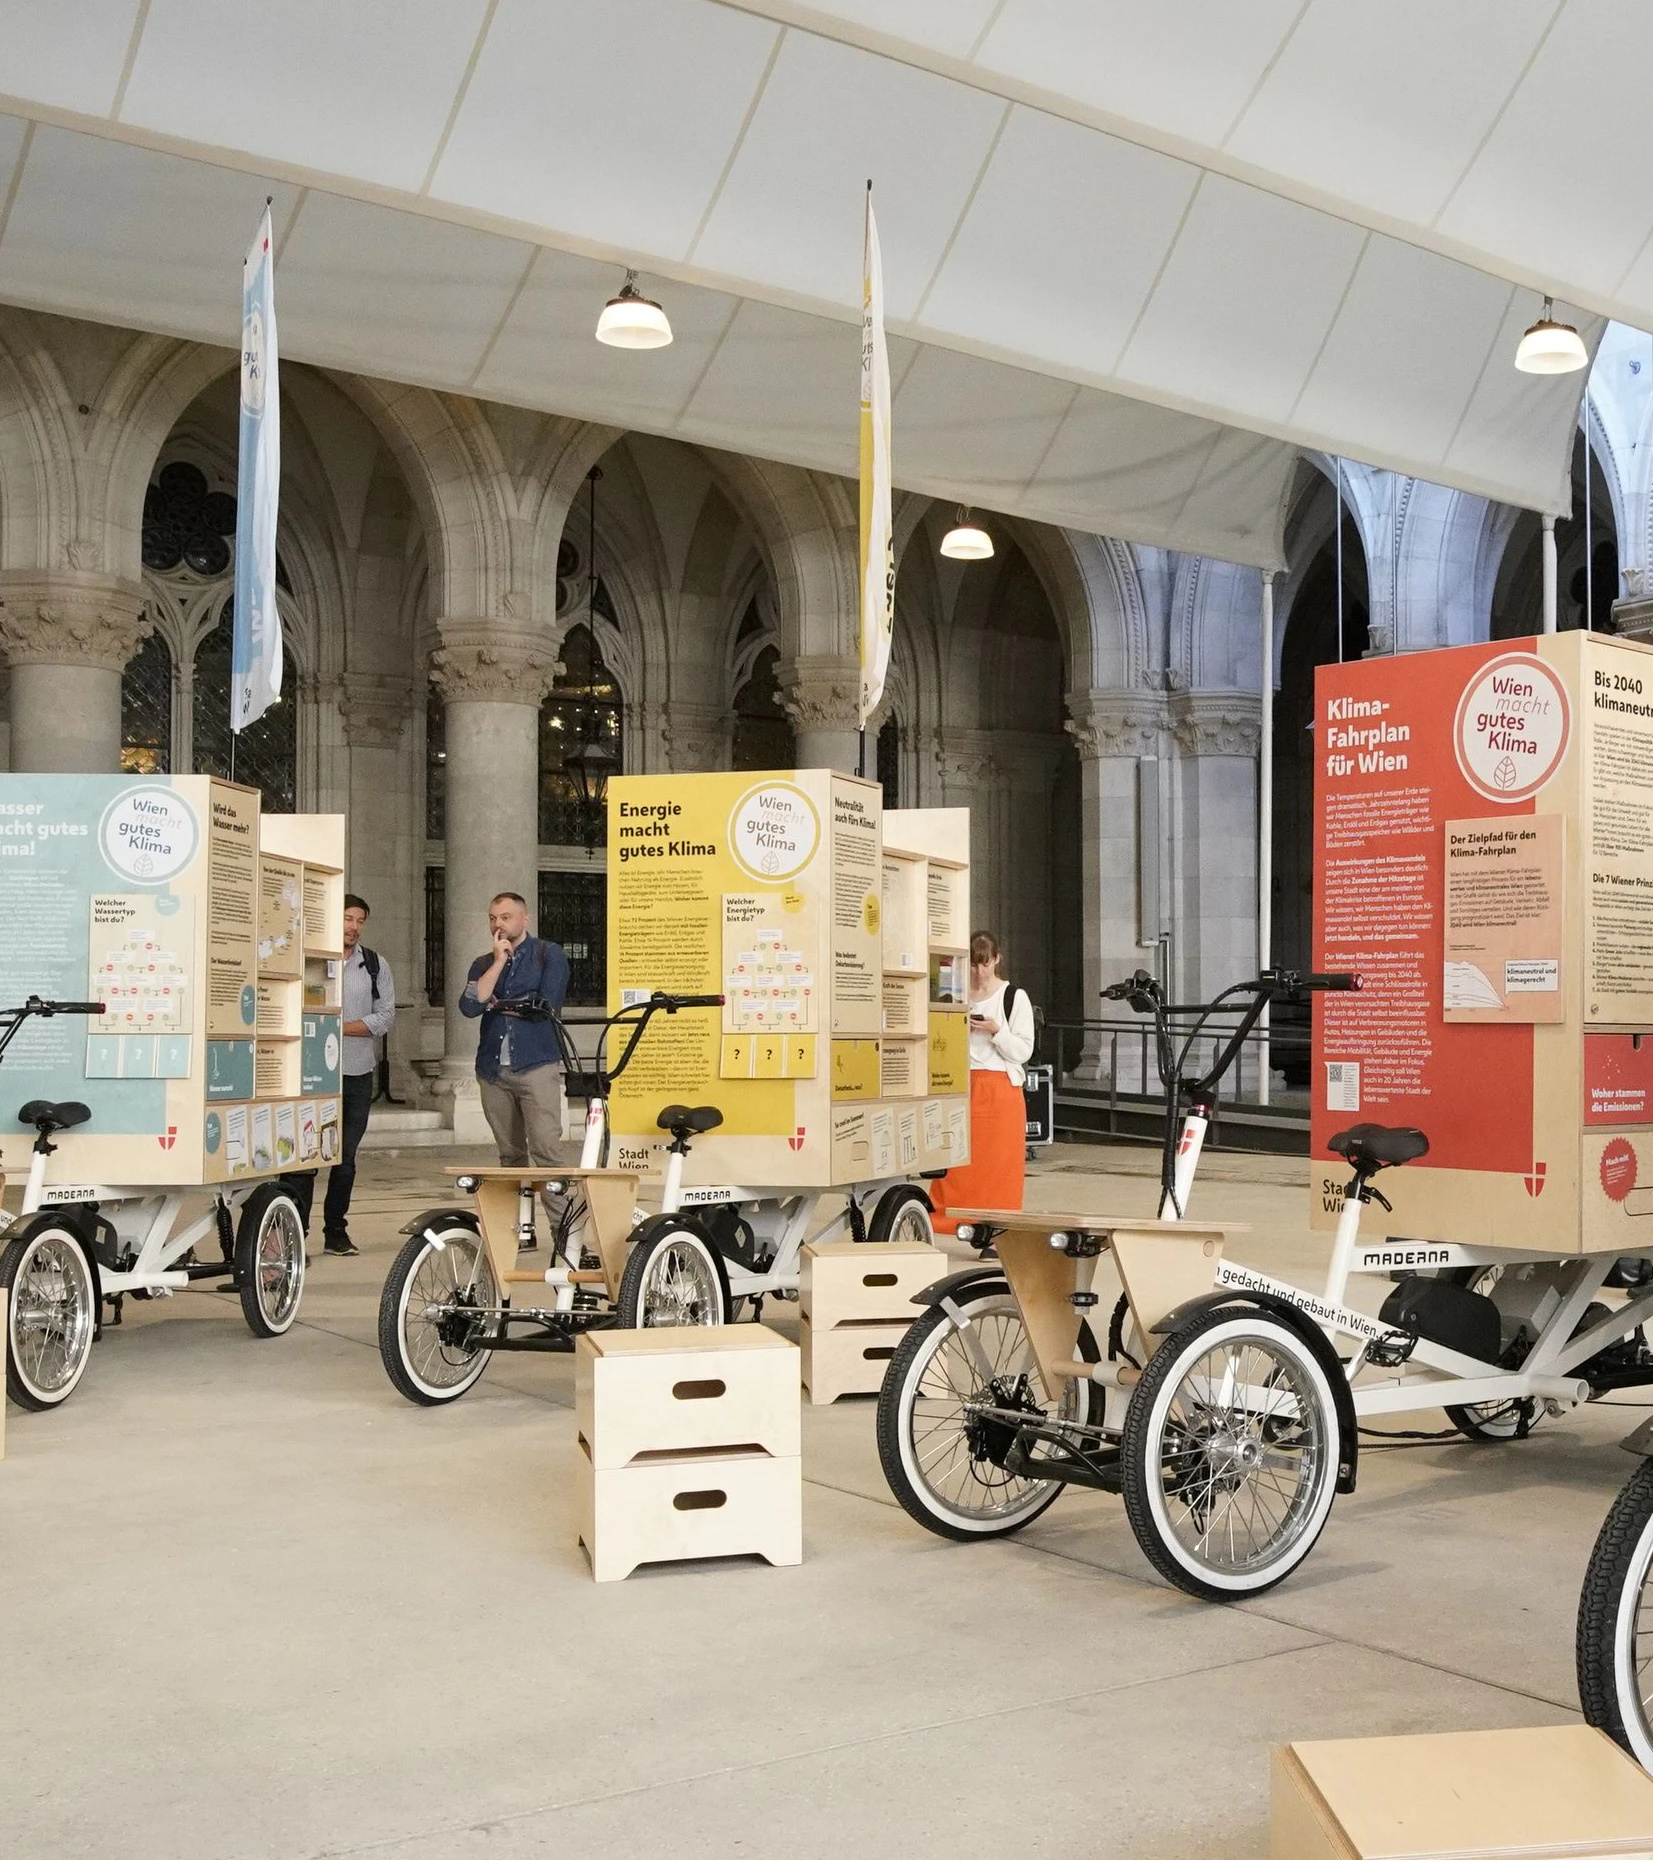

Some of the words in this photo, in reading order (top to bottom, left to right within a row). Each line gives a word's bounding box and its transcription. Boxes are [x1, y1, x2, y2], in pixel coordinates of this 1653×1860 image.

[1493, 676, 1533, 696] Wien
[1594, 670, 1611, 688] Bis
[1613, 675, 1643, 694] 2040
[1327, 697, 1390, 720] Klima-
[1496, 696, 1550, 715] macht
[1477, 712, 1525, 732] gutes
[1327, 721, 1410, 750] Fahrplan
[1488, 731, 1537, 754] Klima
[1326, 754, 1354, 776] für
[1358, 750, 1408, 773] Wien
[0, 803, 44, 815] asser
[133, 798, 168, 816] Wien
[213, 802, 226, 815] Wird
[227, 806, 237, 818] das
[620, 800, 682, 820] Energie
[759, 795, 792, 812] Wien
[835, 796, 864, 812] Neutralität
[213, 816, 232, 830] Wasser
[620, 821, 670, 837] macht
[747, 819, 786, 835] gutes
[835, 813, 847, 823] auch
[859, 816, 876, 830] Klima!
[38, 822, 88, 840] gutes
[119, 822, 161, 838] gutes
[1450, 835, 1465, 845] Der
[1467, 831, 1503, 845] Zielpfad
[1504, 831, 1518, 841] für
[1520, 830, 1536, 840] den
[129, 836, 172, 855] Klima
[756, 832, 796, 852] Klima
[619, 844, 664, 862] gutes
[668, 840, 716, 856] Klima
[1450, 845, 1517, 858] Klima-Fahrplan
[1593, 873, 1604, 883] Die
[1605, 874, 1610, 883] 7
[1610, 875, 1635, 886] Wiener
[727, 898, 755, 906] Welcher
[94, 908, 136, 916] Wassertyp
[727, 906, 766, 916] Energietyp
[1507, 967, 1544, 975] klimaneutral
[1507, 976, 1545, 984] klimagerecht
[1591, 1088, 1614, 1098] Woher
[1615, 1089, 1646, 1098] stammen
[1591, 1102, 1603, 1112] die
[1603, 1101, 1644, 1112] Emissionen?
[619, 1148, 649, 1159] Stadt
[47, 1189, 95, 1201] MADERNA
[1323, 1179, 1347, 1195] Sta
[684, 1190, 731, 1201] MADERNA
[1364, 1250, 1449, 1266] MADERNA
[1222, 1266, 1270, 1295] gedacht
[1272, 1286, 1295, 1304] und
[1296, 1297, 1335, 1321] gebaut
[1337, 1310, 1347, 1324] in
[1350, 1317, 1380, 1339] Wien.
